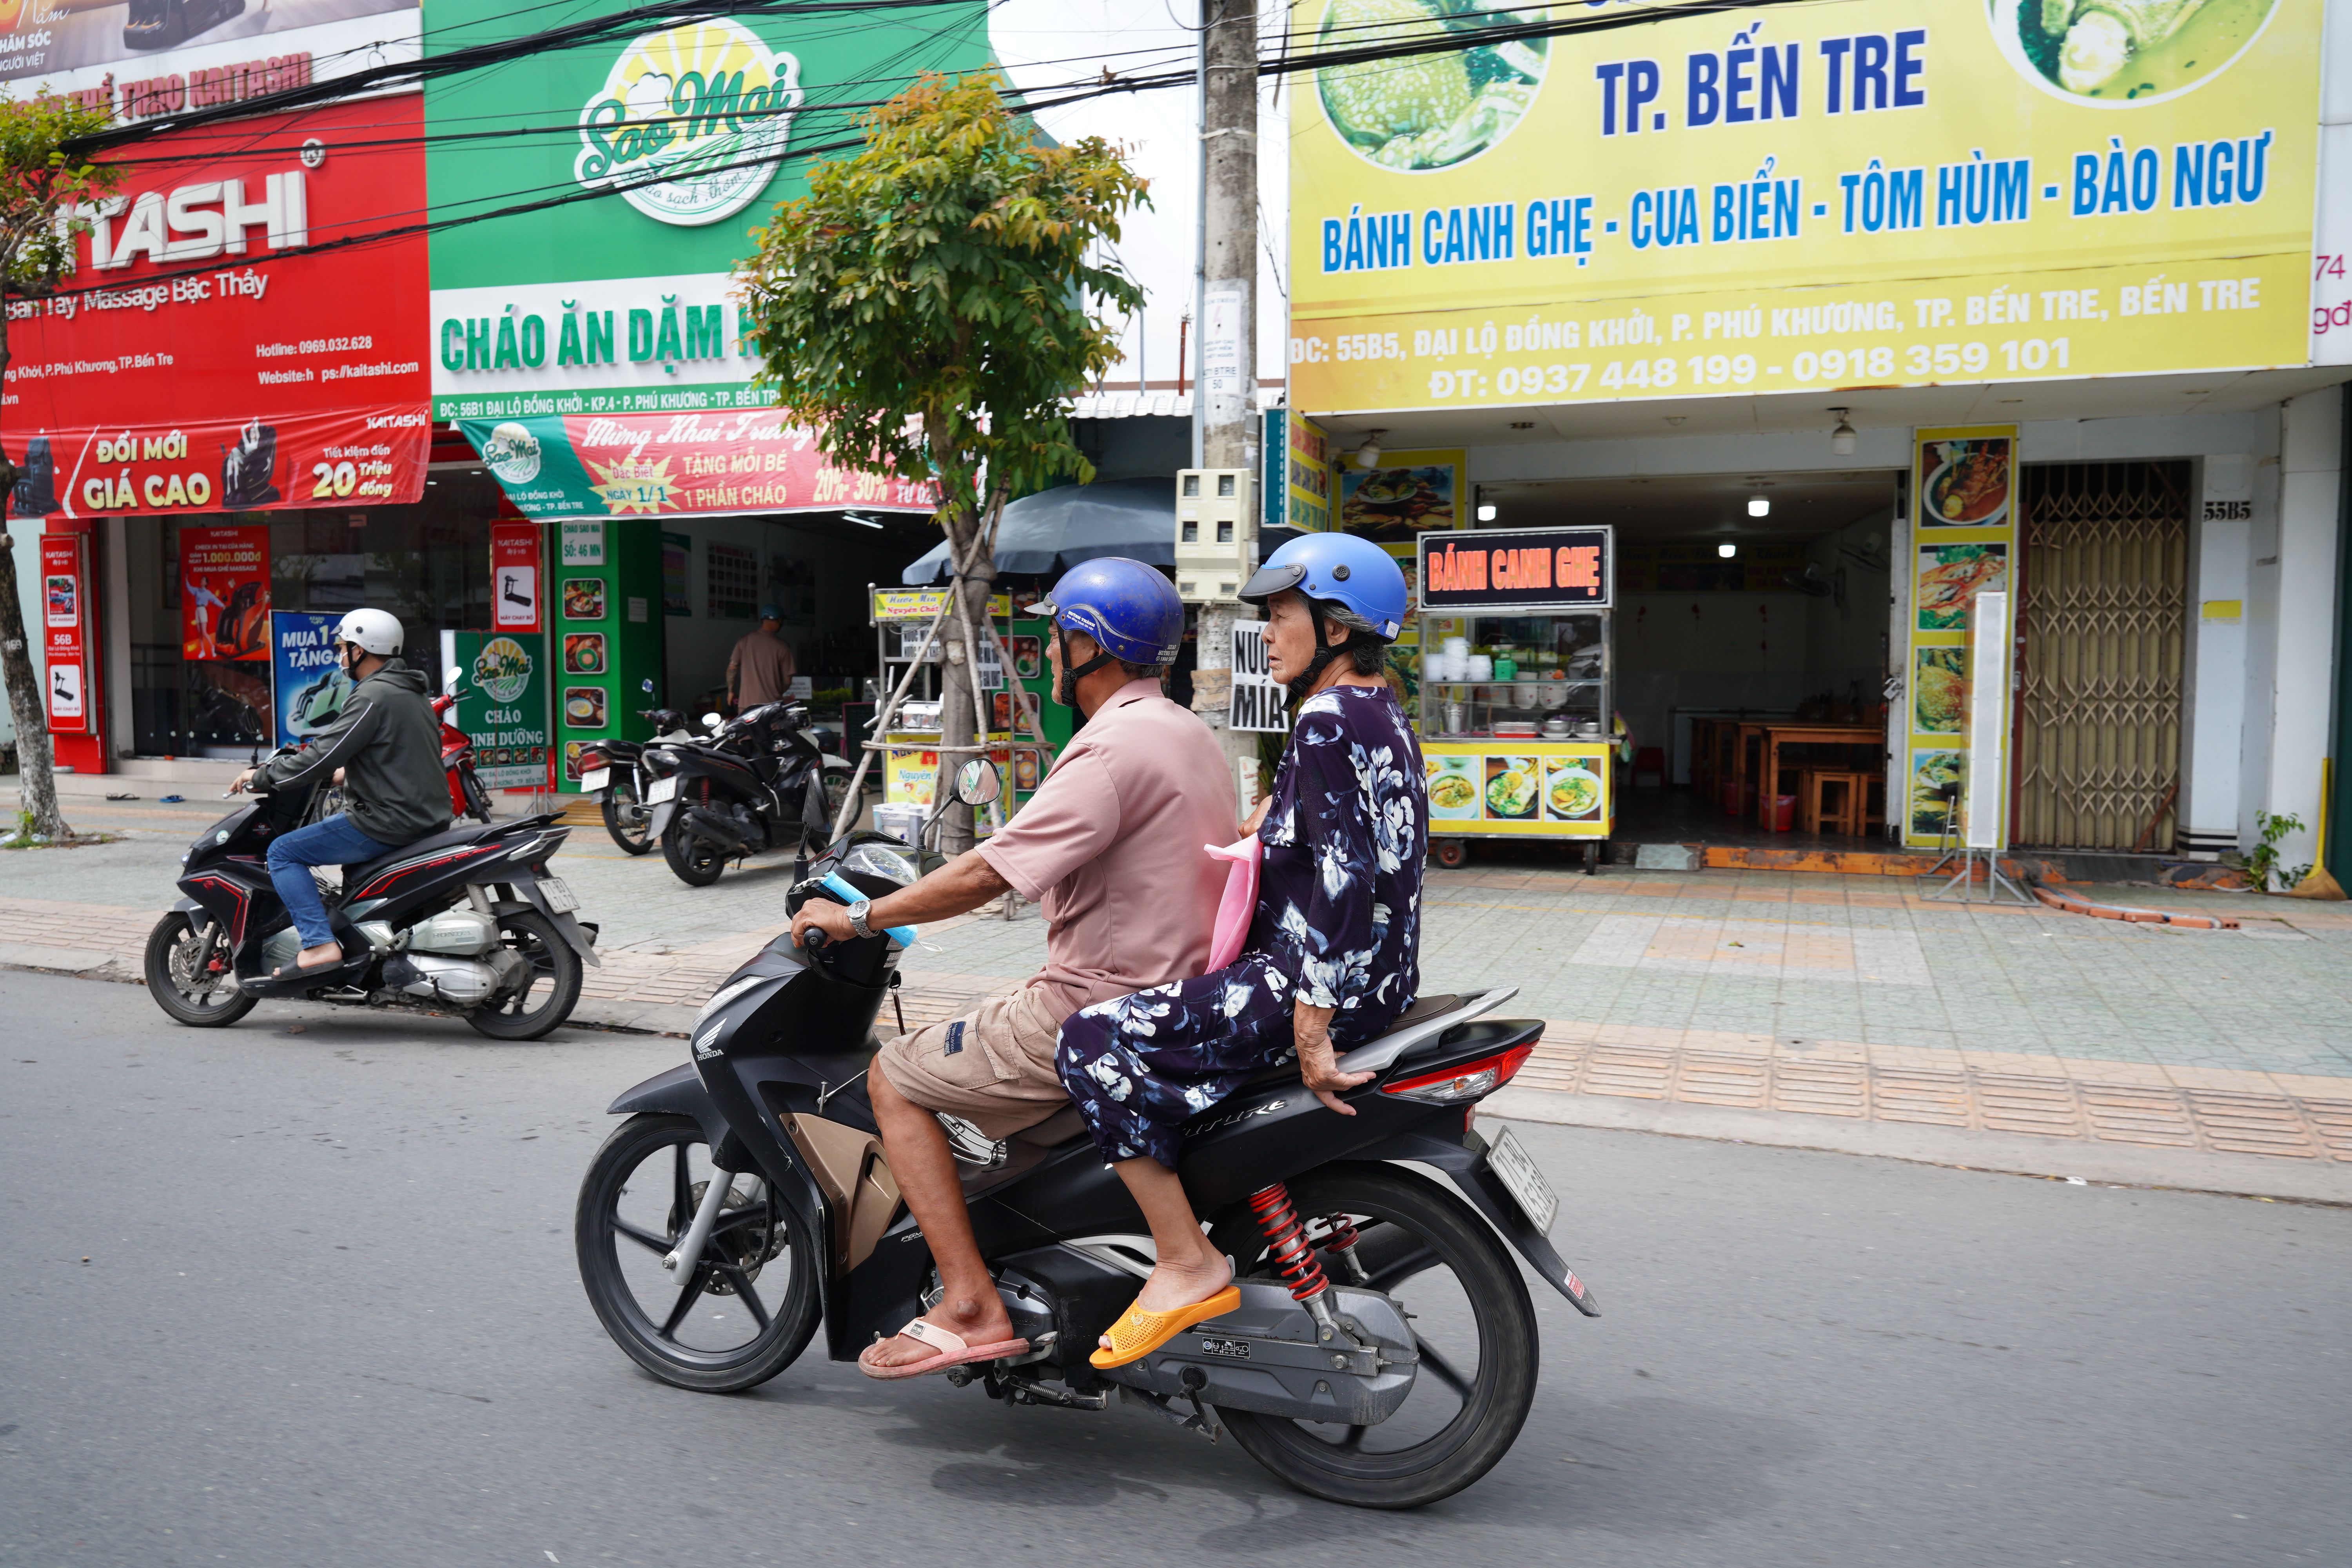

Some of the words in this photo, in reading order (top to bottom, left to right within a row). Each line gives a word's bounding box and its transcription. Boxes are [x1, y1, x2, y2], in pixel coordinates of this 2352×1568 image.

[27, 28, 51, 49] SÓC
[26, 51, 45, 67] VIỆT
[119, 74, 185, 118] THAO
[190, 51, 311, 107] KAITASHI
[1597, 59, 1666, 136] TP.
[1688, 21, 1800, 127] BẾN
[1820, 29, 1926, 114] TRE
[583, 99, 676, 179] Sao
[673, 63, 791, 140] Mai
[1323, 205, 1412, 272] BÁNH
[1423, 203, 1513, 265] CANH
[1527, 197, 1593, 267] GHẸ
[1631, 187, 1700, 248] CUA
[1714, 157, 1800, 241] BIỂN
[1841, 160, 1923, 232] TÔM
[1937, 150, 2031, 225] HÙM
[2073, 138, 2158, 216] BÀO
[2173, 130, 2272, 208] NGƯ
[2316, 254, 2346, 281] 74
[46, 297, 77, 319] Tay
[84, 285, 169, 311] Massage
[172, 276, 211, 303] Bậc
[215, 268, 268, 299] Thầy
[1290, 338, 1329, 364] ĐC:
[1336, 332, 1406, 362] 55B5,
[1414, 328, 1457, 361] ĐẠI
[1466, 321, 1495, 358] LỘ
[1506, 315, 1580, 353] ĐỒNG
[1590, 308, 1662, 347] KHỞI,
[1672, 312, 1693, 341] P.
[1703, 304, 1760, 339] PHÚ
[1771, 300, 1904, 337] KHƯƠNG,
[1915, 297, 1955, 328] TP.
[1966, 285, 2031, 325] BẾN
[2041, 288, 2109, 321] TRE,
[2120, 274, 2188, 317] BẾN
[2198, 278, 2261, 310] TRE
[441, 304, 544, 372] CHÁO
[557, 299, 615, 366] ĂN
[628, 294, 723, 374] DẶM
[256, 344, 297, 357] Hotline:
[299, 336, 372, 353] 0969.032.628
[157, 353, 173, 365] Tre
[1429, 370, 1487, 398] ĐT:
[1497, 364, 1591, 396] 0937
[1600, 358, 1676, 390] 448
[1687, 354, 1756, 386] 199
[1794, 347, 1894, 381] 0918
[1905, 342, 1989, 375] 359
[1999, 338, 2070, 371] 101
[440, 403, 458, 417] ĐC:
[460, 402, 483, 416] 56B1
[486, 400, 504, 417] ĐẠI
[507, 397, 521, 417] LỘ
[524, 394, 554, 414] ĐỒNG
[557, 392, 583, 412] KHỞI
[591, 396, 614, 411] KP.4
[623, 396, 633, 410] P.
[635, 391, 657, 409] PHÚ
[661, 391, 707, 408] KHƯƠNG
[735, 384, 759, 405] BẾN
[366, 414, 426, 429] KAITASHI
[96, 430, 138, 463] ĐỔI
[144, 429, 187, 461] MỚI
[582, 416, 652, 458] Mừng
[657, 414, 724, 443] Khai
[323, 446, 343, 458] Tiết
[344, 445, 369, 459] kiệm
[370, 443, 390, 455] đến
[484, 444, 512, 466] Sao
[683, 453, 726, 478] TẶNG
[731, 446, 760, 473] MỖI
[764, 449, 787, 472] BÉ
[313, 461, 356, 497] 20
[359, 460, 392, 478] Triệu
[612, 466, 633, 482] Đặc
[635, 466, 654, 481] Biệt
[83, 468, 138, 509] GIÁ
[144, 472, 211, 507] CAO
[359, 483, 392, 497] đồng
[606, 486, 632, 502] NGÀY
[685, 491, 692, 507] 1
[697, 481, 737, 506] PHẦN
[742, 481, 786, 505] CHÁO
[2204, 501, 2250, 522] 55B5
[564, 524, 578, 533] CHÁO
[579, 524, 589, 533] SAO
[591, 524, 600, 533] MAI
[497, 538, 533, 547] KAITASHI
[564, 539, 576, 557] SỐ:
[579, 544, 587, 557] 46
[590, 544, 601, 556] MN
[203, 551, 261, 563] 1.000.000đ
[1428, 543, 1487, 592] BÁNH
[1491, 548, 1549, 590] CANH
[1555, 546, 1601, 596] GHẸ
[920, 604, 939, 613] Chất
[54, 634, 72, 645] 56B
[282, 630, 318, 648] MUA
[319, 624, 328, 646] 1
[289, 647, 334, 671] TẶNG
[1233, 679, 1285, 729] MÍA
[485, 706, 521, 724] CHÁO
[499, 728, 543, 746] DƯỠNG
[898, 769, 931, 782] Nguyên
[433, 929, 472, 938] HONDA
[697, 1049, 724, 1061] HONDA
